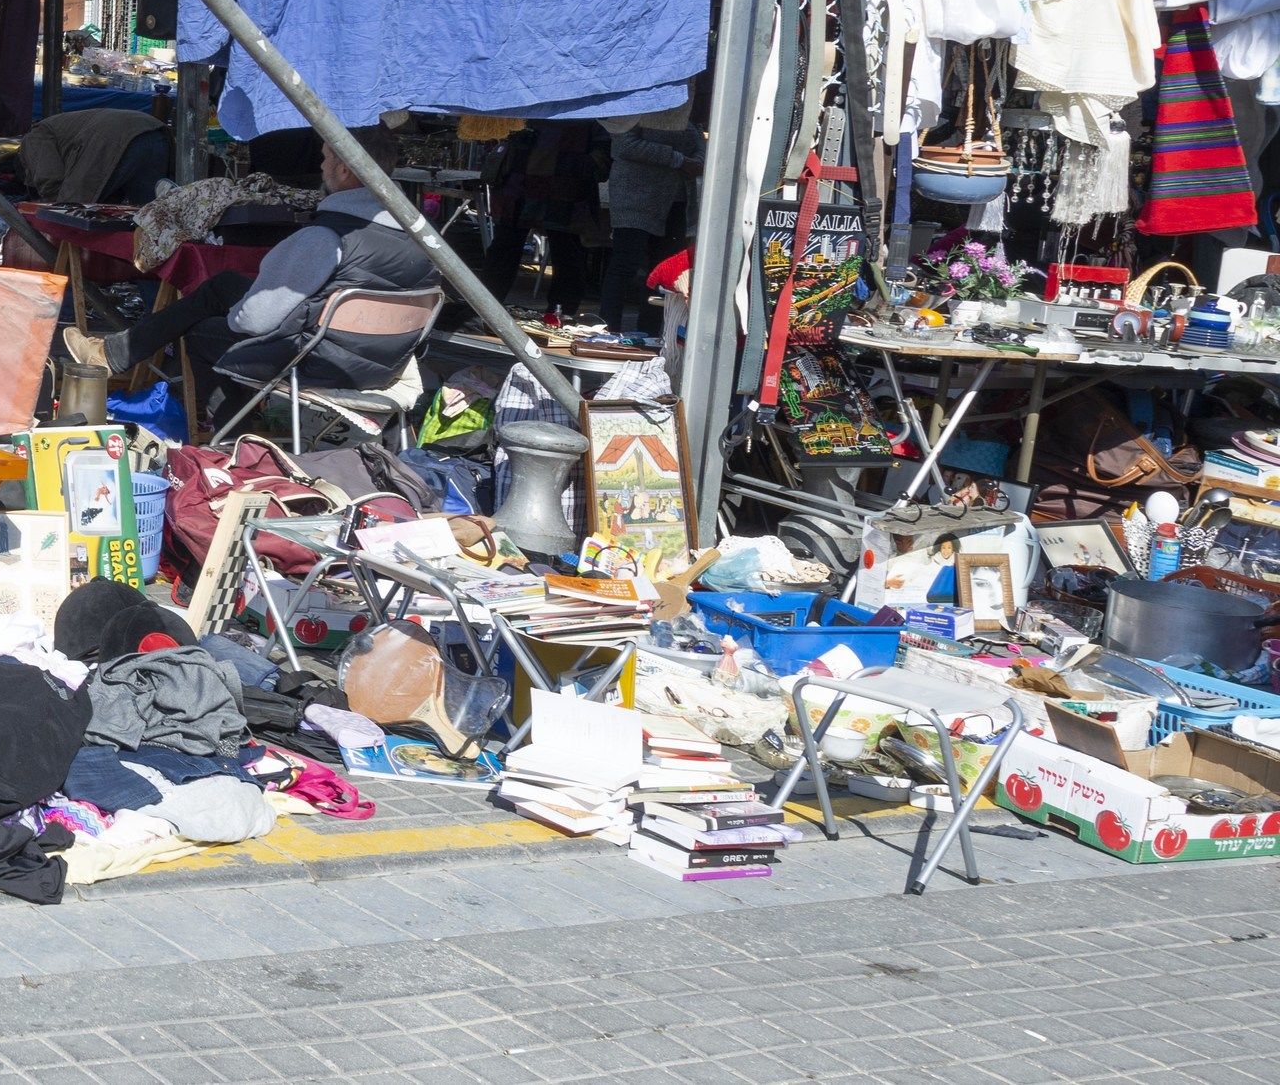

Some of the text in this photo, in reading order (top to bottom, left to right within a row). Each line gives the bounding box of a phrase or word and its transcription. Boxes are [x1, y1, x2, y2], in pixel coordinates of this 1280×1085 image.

[764, 210, 862, 232] AUSRALIA
[102, 552, 109, 562] TV
[109, 540, 126, 584] BRAC
[124, 539, 139, 589] GOLD
[1038, 766, 1106, 805] משק עוזר
[1214, 837, 1276, 855] משק עוזר
[722, 854, 748, 864] GREY
